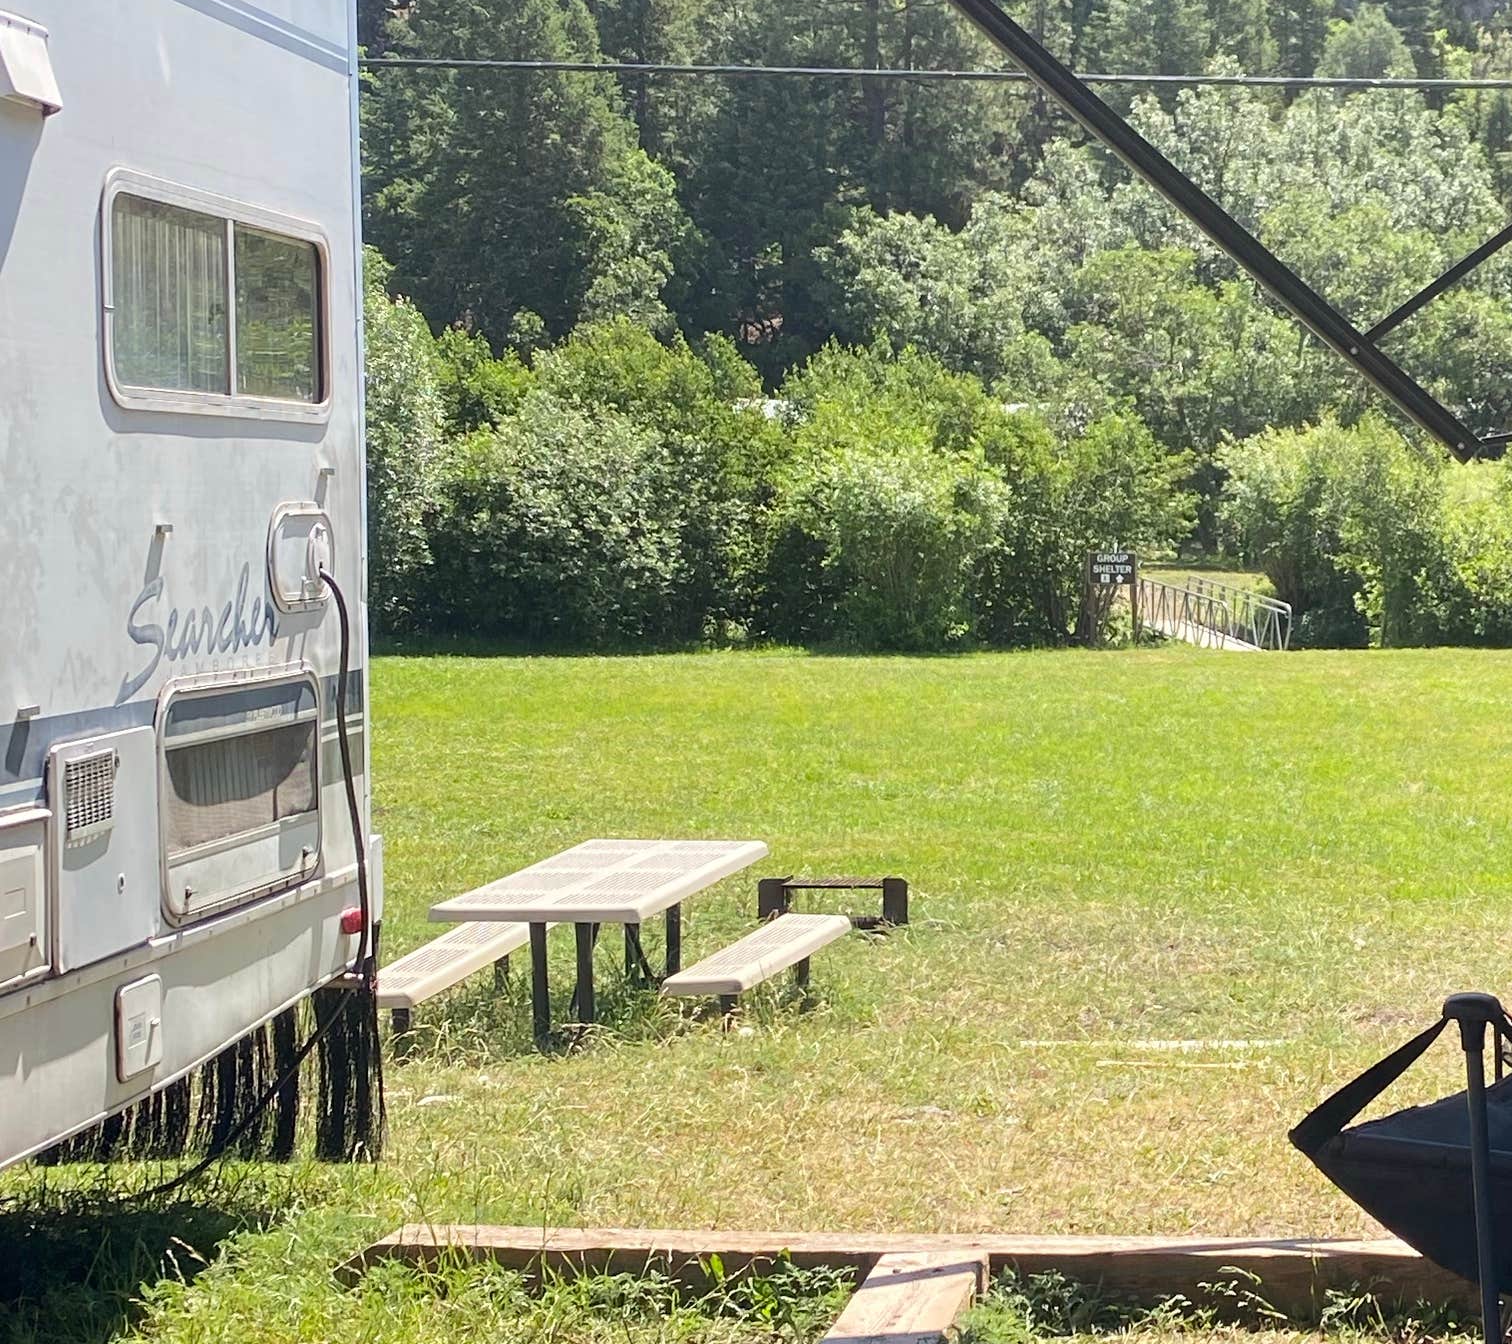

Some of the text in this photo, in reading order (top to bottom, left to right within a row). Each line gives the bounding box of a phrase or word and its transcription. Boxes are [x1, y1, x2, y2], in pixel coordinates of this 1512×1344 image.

[1096, 554, 1129, 563] GROUP
[1092, 564, 1132, 574] SHELTER
[115, 561, 280, 708] Searcher
